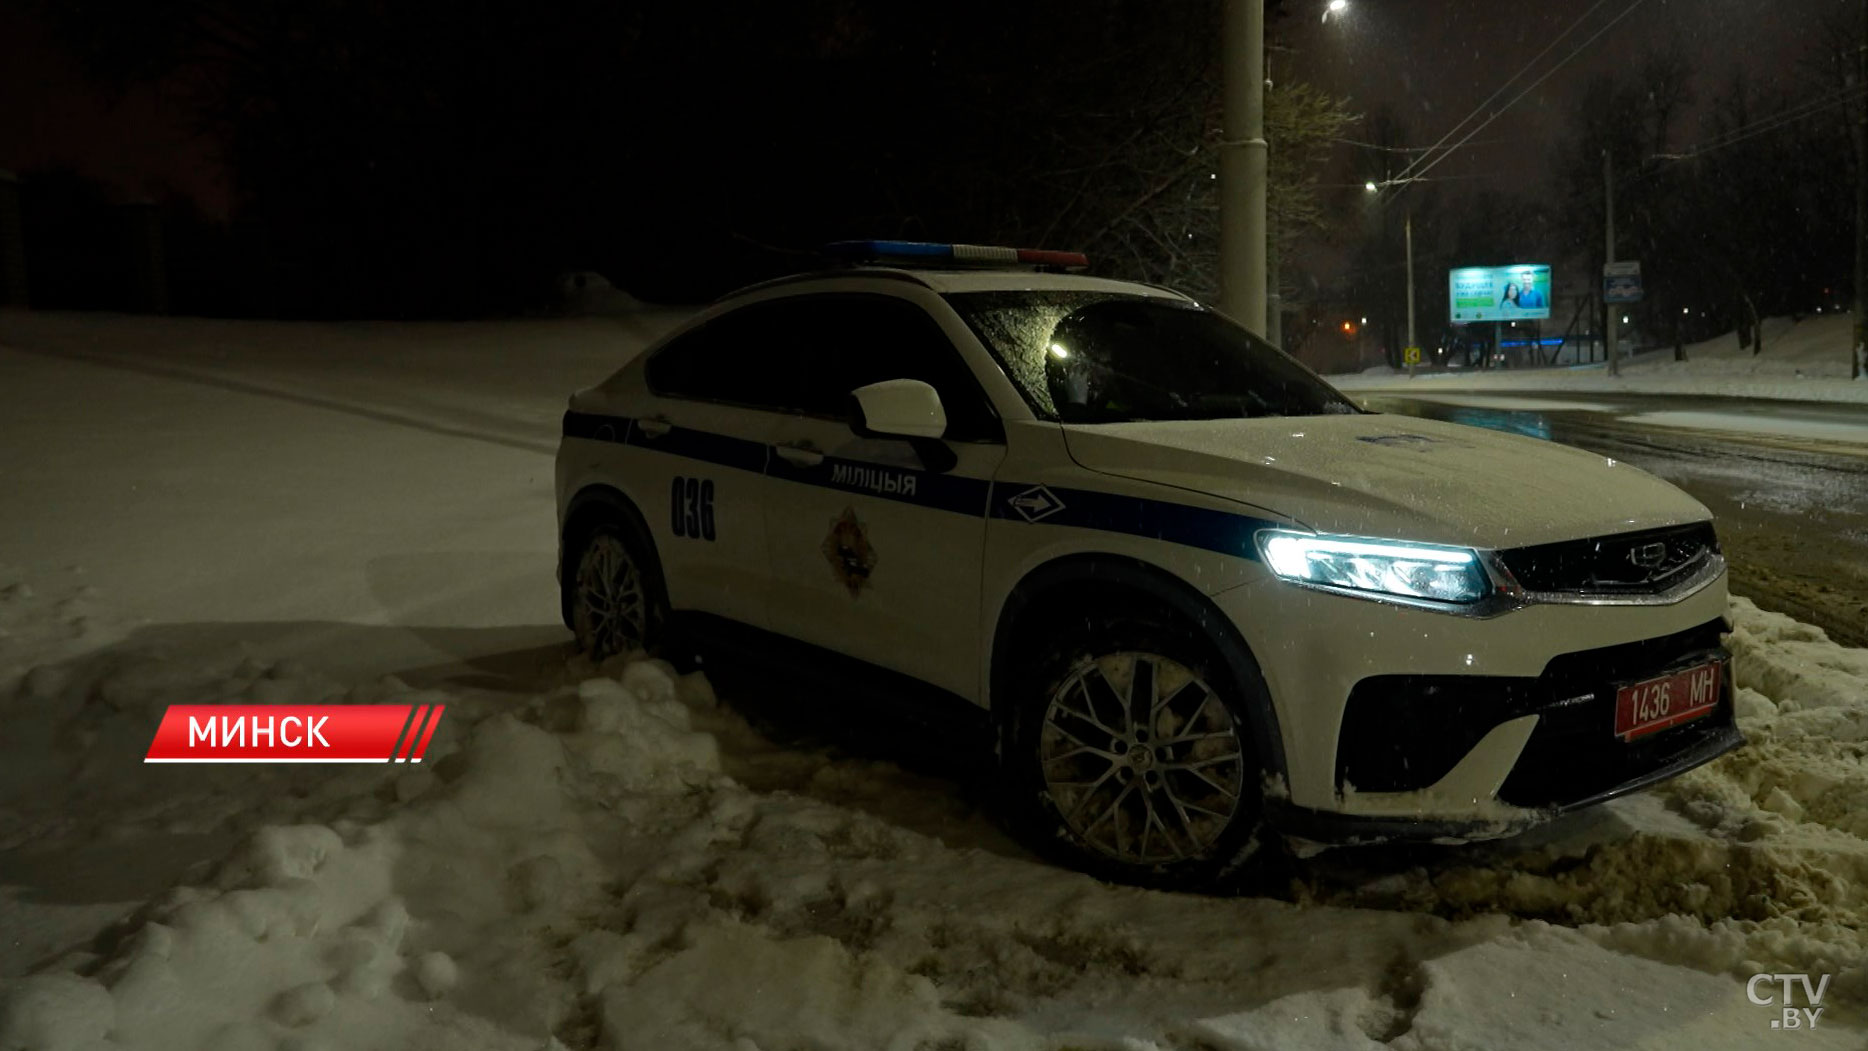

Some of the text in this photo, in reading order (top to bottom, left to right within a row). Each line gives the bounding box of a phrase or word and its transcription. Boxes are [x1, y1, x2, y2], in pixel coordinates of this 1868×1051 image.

[831, 463, 917, 496] МІЛІЦЫЯ
[672, 476, 715, 541] 036
[1631, 682, 1670, 725] 1436
